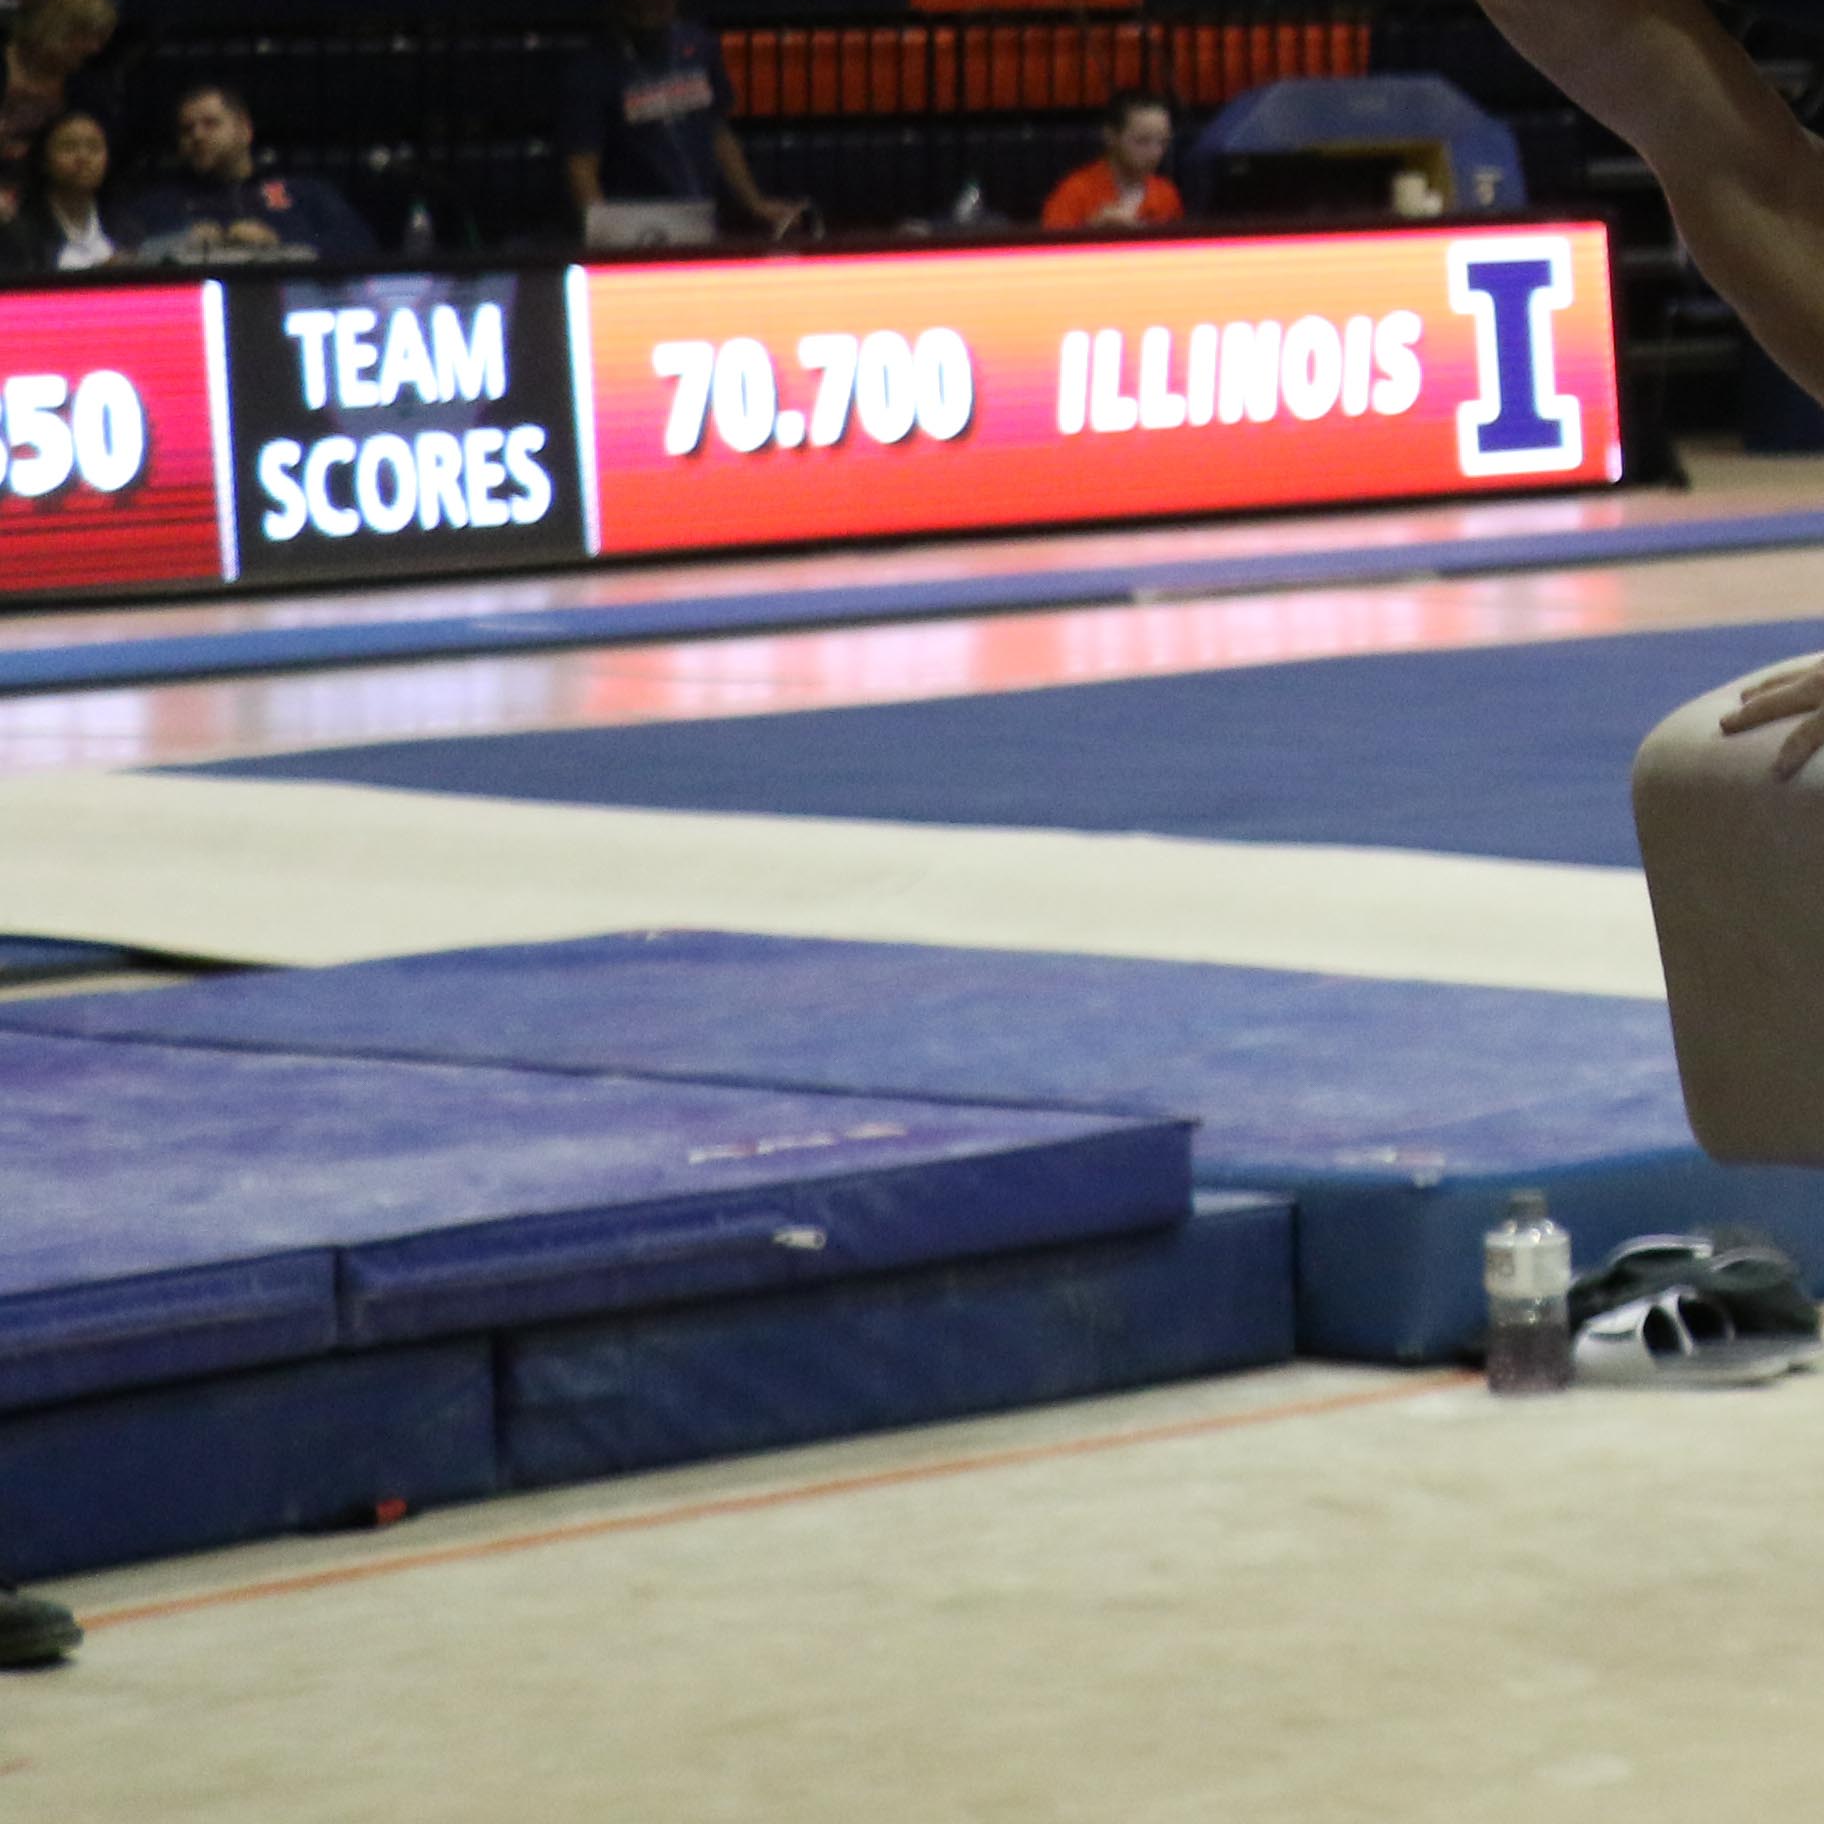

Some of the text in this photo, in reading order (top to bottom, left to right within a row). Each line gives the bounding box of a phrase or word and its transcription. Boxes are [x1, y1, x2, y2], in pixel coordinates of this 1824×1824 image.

[284, 301, 508, 410] TEAM
[653, 326, 974, 455] 70.700
[1057, 310, 1423, 435] ILLINOIS
[257, 424, 554, 542] SCORES
